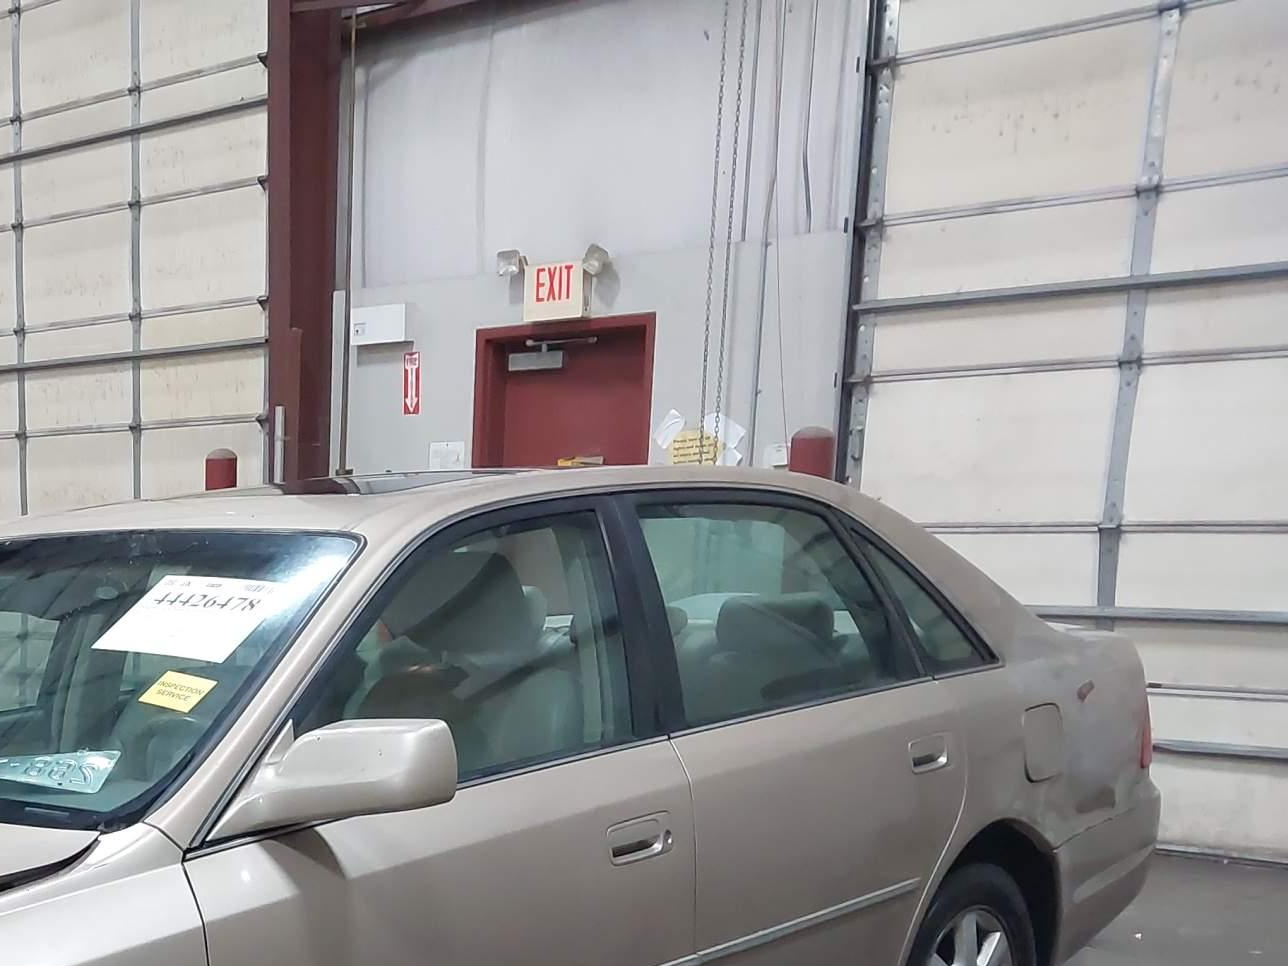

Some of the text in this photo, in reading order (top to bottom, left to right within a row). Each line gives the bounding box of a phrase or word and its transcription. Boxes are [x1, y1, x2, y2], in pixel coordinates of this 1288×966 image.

[535, 265, 573, 303] EXIT
[154, 592, 261, 611] 44426478
[156, 688, 191, 702] SERVICE
[157, 680, 205, 696] INSPECTION
